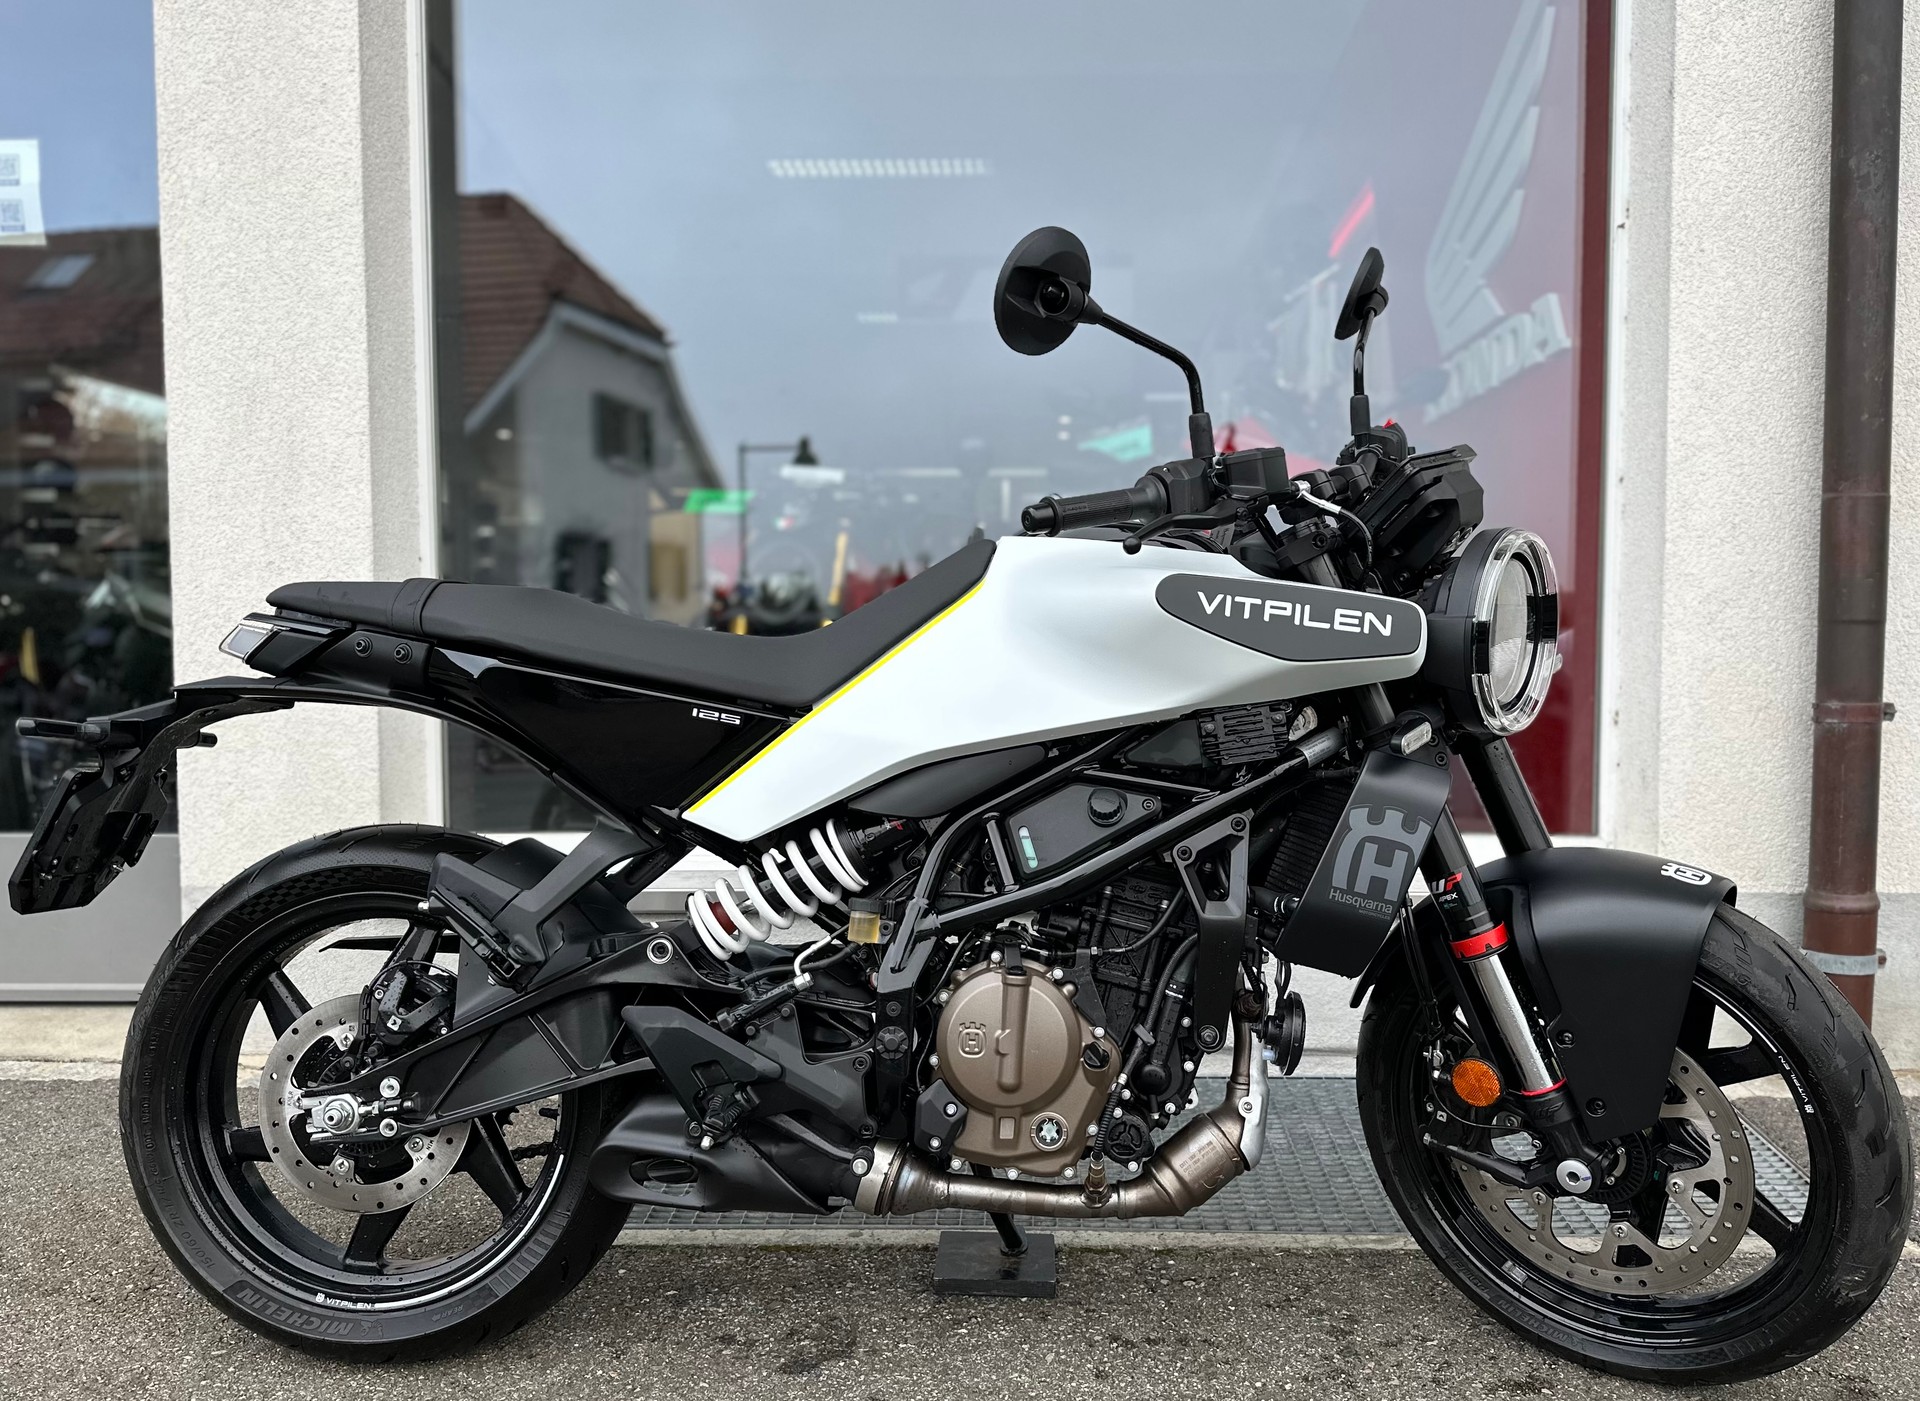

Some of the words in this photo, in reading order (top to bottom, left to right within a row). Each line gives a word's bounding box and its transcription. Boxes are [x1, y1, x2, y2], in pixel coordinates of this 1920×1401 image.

[1197, 591, 1392, 637] VITPILEN
[692, 708, 741, 725] 125
[1329, 888, 1393, 914] Husqvarna
[1778, 1055, 1808, 1102] VITPILEN
[181, 1231, 216, 1269] 150/60
[237, 1287, 354, 1336] MICHELIN
[326, 1297, 371, 1310] VITPILEN
[441, 1305, 464, 1321] REAR
[1500, 1300, 1569, 1342] MICHELIN
